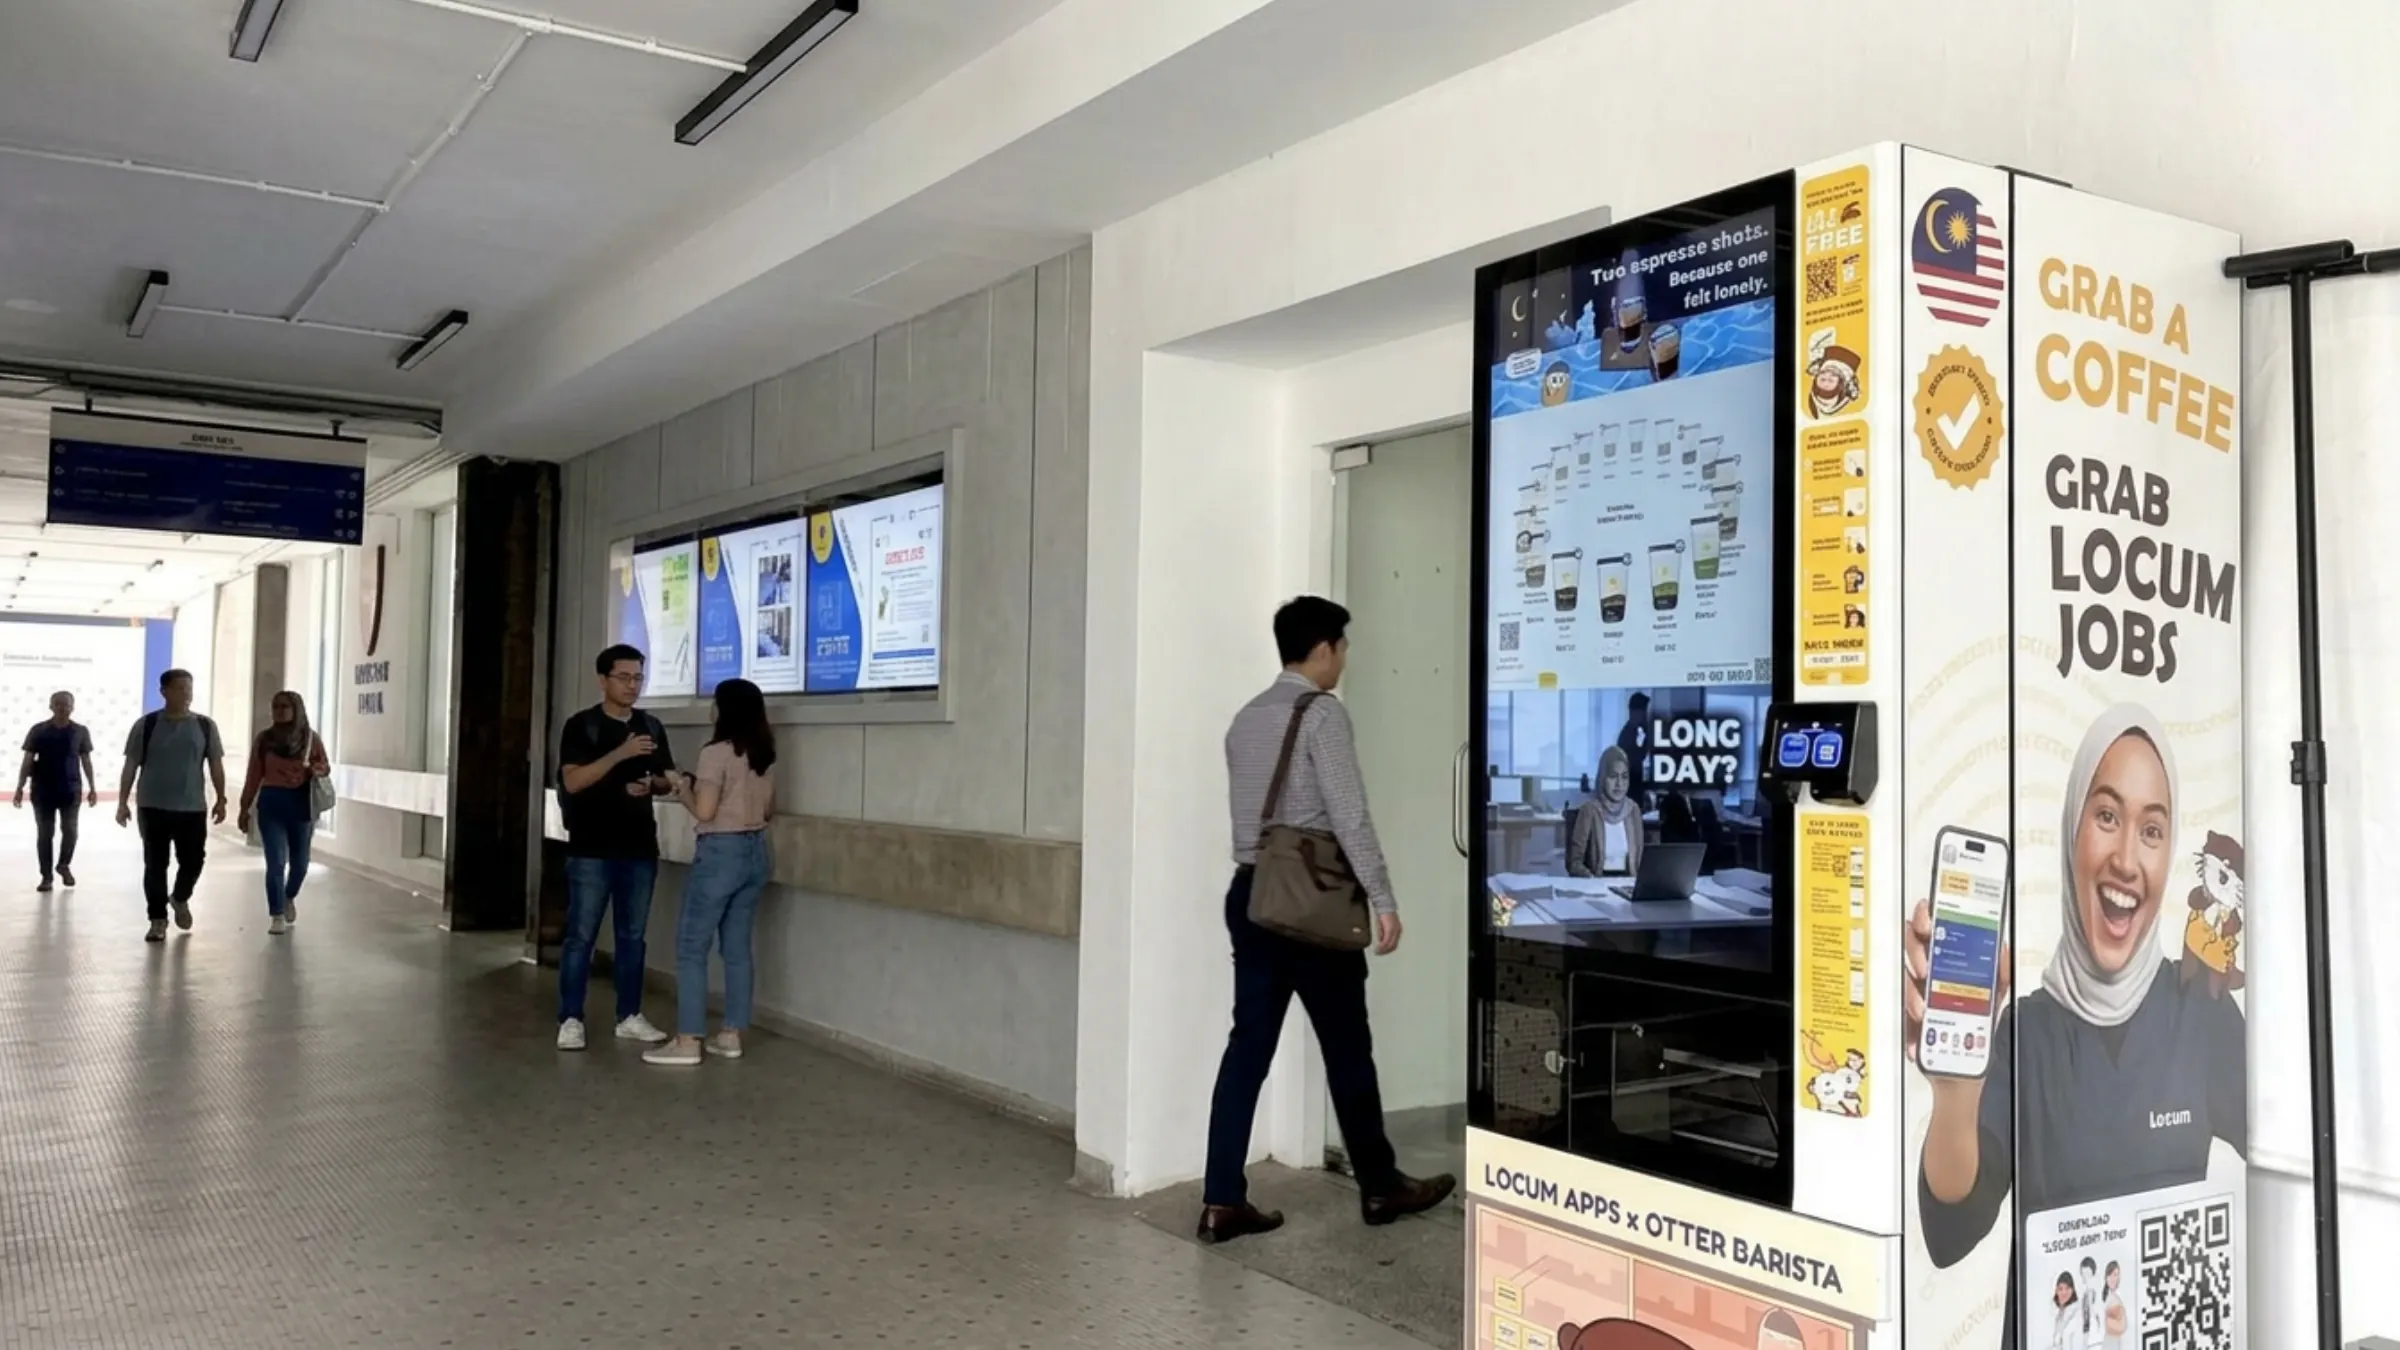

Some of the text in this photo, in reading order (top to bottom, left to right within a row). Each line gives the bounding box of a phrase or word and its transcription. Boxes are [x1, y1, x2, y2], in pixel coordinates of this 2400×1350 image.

[1711, 224, 1769, 250] shots.
[1806, 224, 1863, 255] FREE
[1669, 251, 1768, 287] Because one
[1684, 276, 1768, 309] felt lonely.
[2038, 257, 2189, 355] GRAB A
[2036, 333, 2234, 453] COFFEE
[2046, 454, 2170, 527] GRAB
[2051, 525, 2236, 624] LOCUM
[2057, 603, 2178, 683] JOBS
[1653, 719, 1741, 748] LONG
[1653, 755, 1738, 783] DAY?
[2150, 1109, 2191, 1128] Locum
[1485, 1164, 1558, 1206] LOCUM
[1564, 1188, 1620, 1224] APPS
[1646, 1212, 1726, 1259] OTTER
[1733, 1243, 1843, 1293] BARISTA
